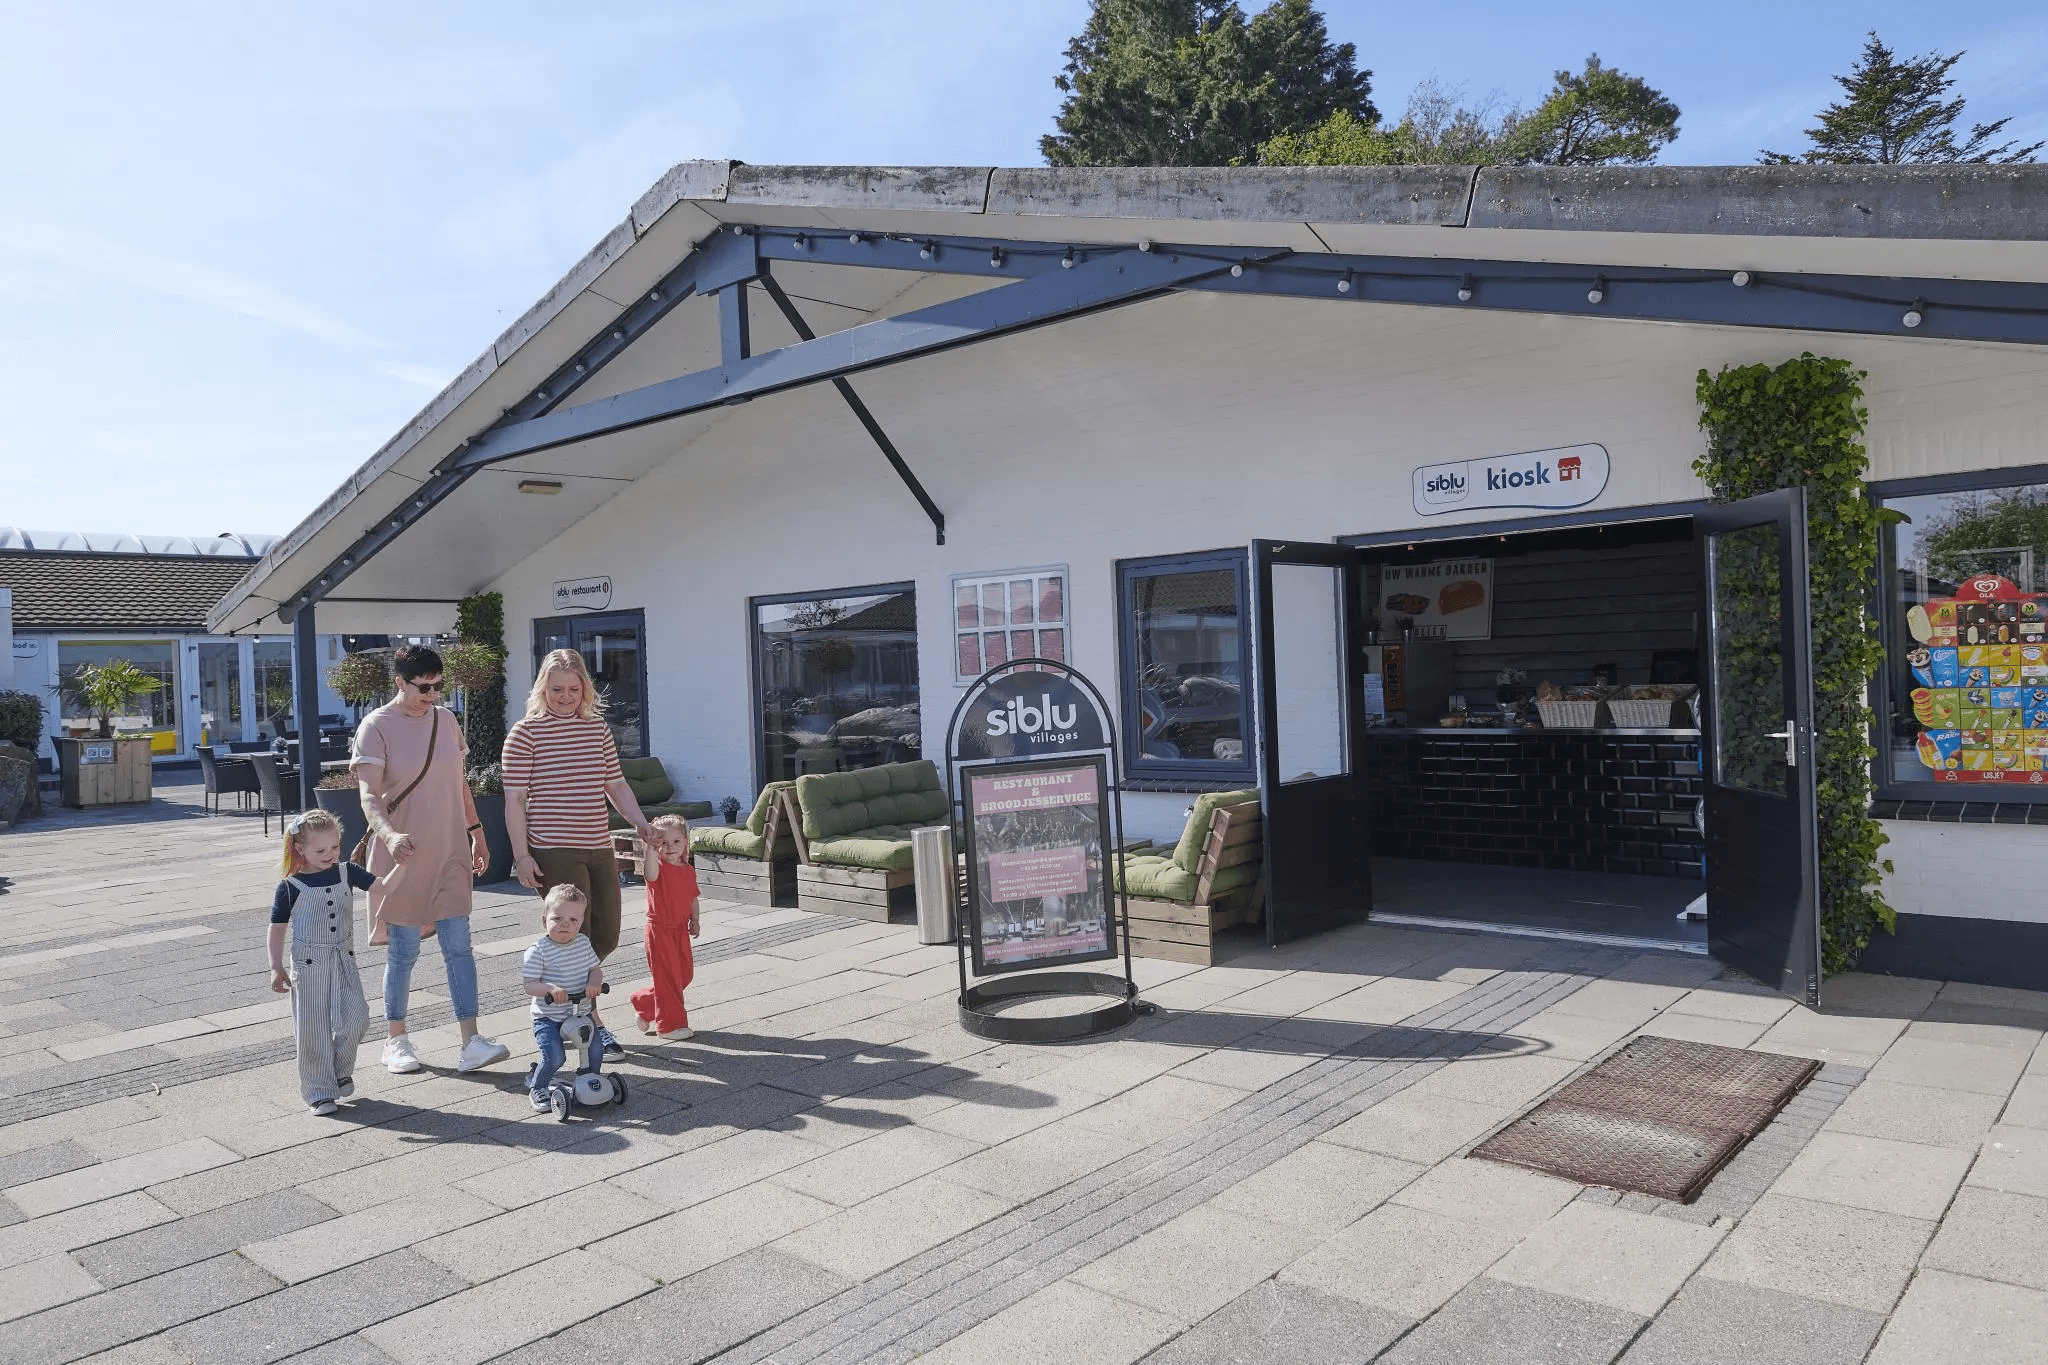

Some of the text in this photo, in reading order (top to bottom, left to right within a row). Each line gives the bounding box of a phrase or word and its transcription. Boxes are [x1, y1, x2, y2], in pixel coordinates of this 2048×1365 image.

[1426, 461, 1551, 493] siblu kiosk
[1384, 562, 1488, 580] UW WARME BAKKER
[571, 583, 602, 596] restaurant
[986, 693, 1077, 737] siblu
[1030, 731, 1078, 744] villages
[993, 774, 1073, 790] RESTAURANT
[1031, 787, 1040, 797] &
[979, 792, 1092, 812] BROODJESSERVICE
